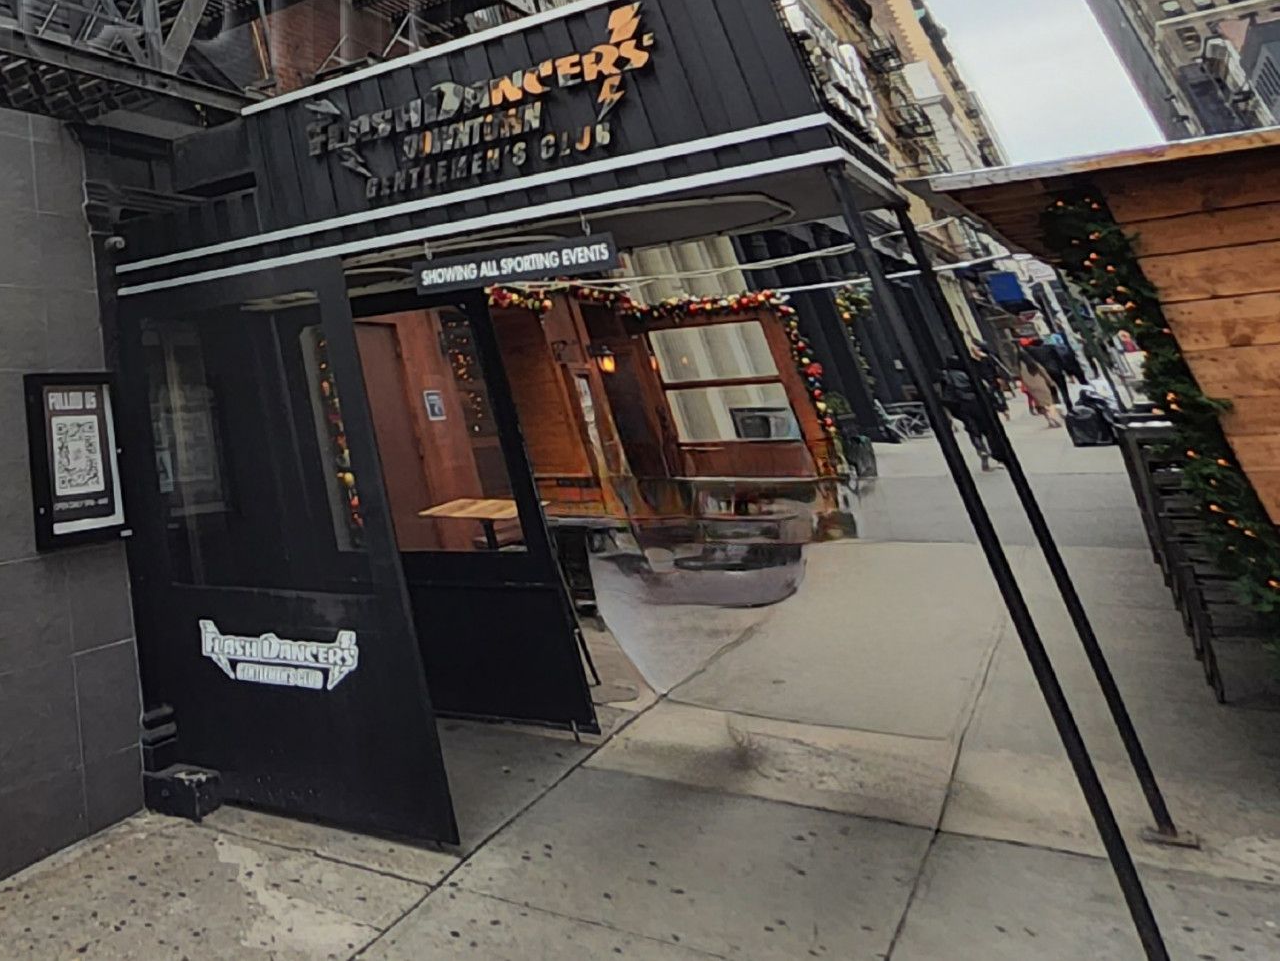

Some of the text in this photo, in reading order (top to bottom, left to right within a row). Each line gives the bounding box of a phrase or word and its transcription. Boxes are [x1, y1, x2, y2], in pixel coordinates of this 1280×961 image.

[366, 142, 527, 199] GENTLEMEN'S
[421, 242, 610, 286] SHOWING ALL SPORTING EVENTS
